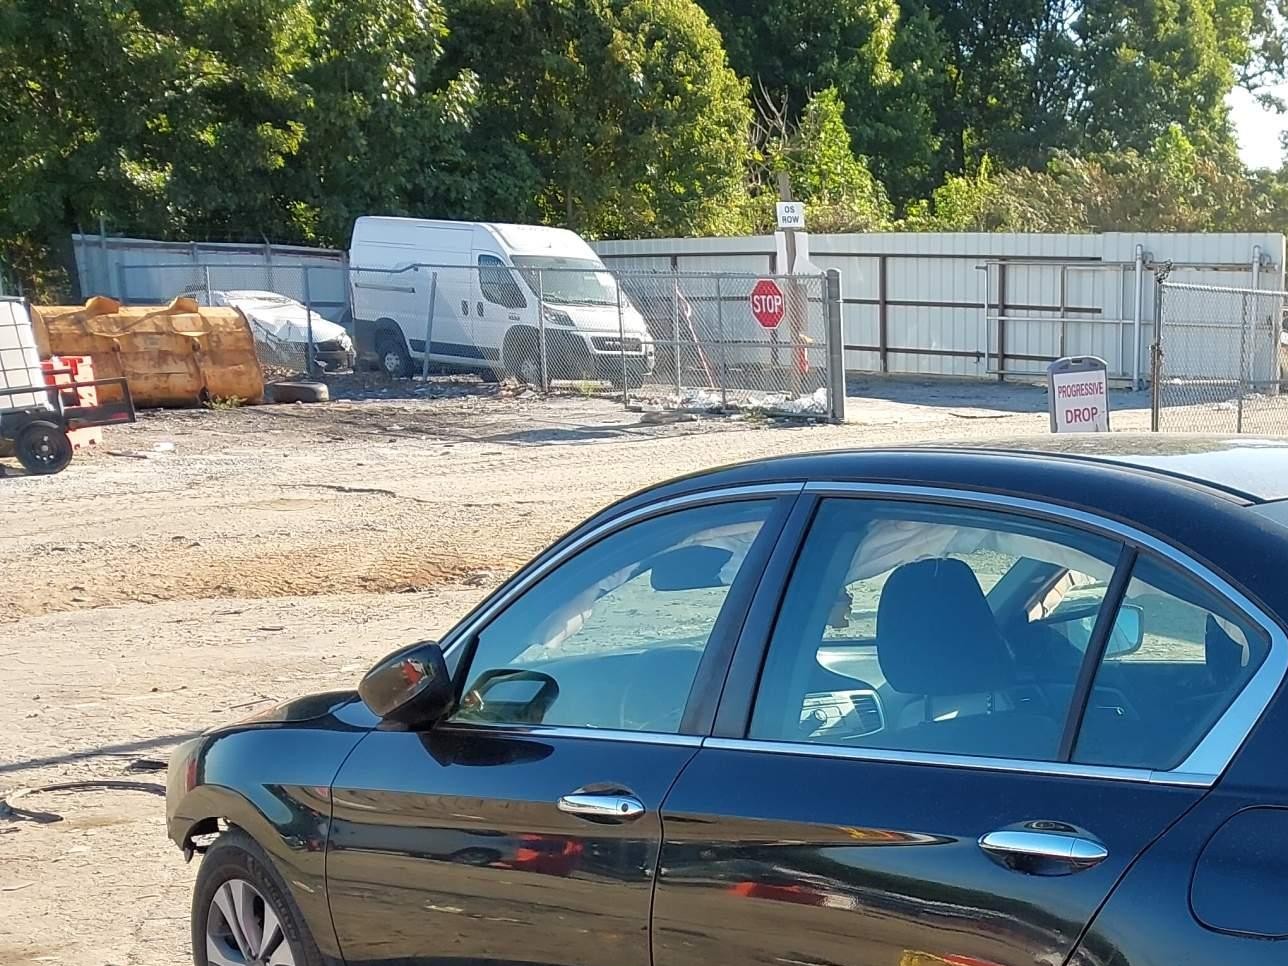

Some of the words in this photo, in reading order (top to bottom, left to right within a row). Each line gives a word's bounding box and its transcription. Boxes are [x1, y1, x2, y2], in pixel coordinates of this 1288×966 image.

[784, 205, 796, 214] OS
[781, 215, 800, 224] ROW
[753, 295, 783, 313] STOP
[1057, 381, 1104, 399] PROGRESSIVE
[1065, 406, 1098, 424] DROP
